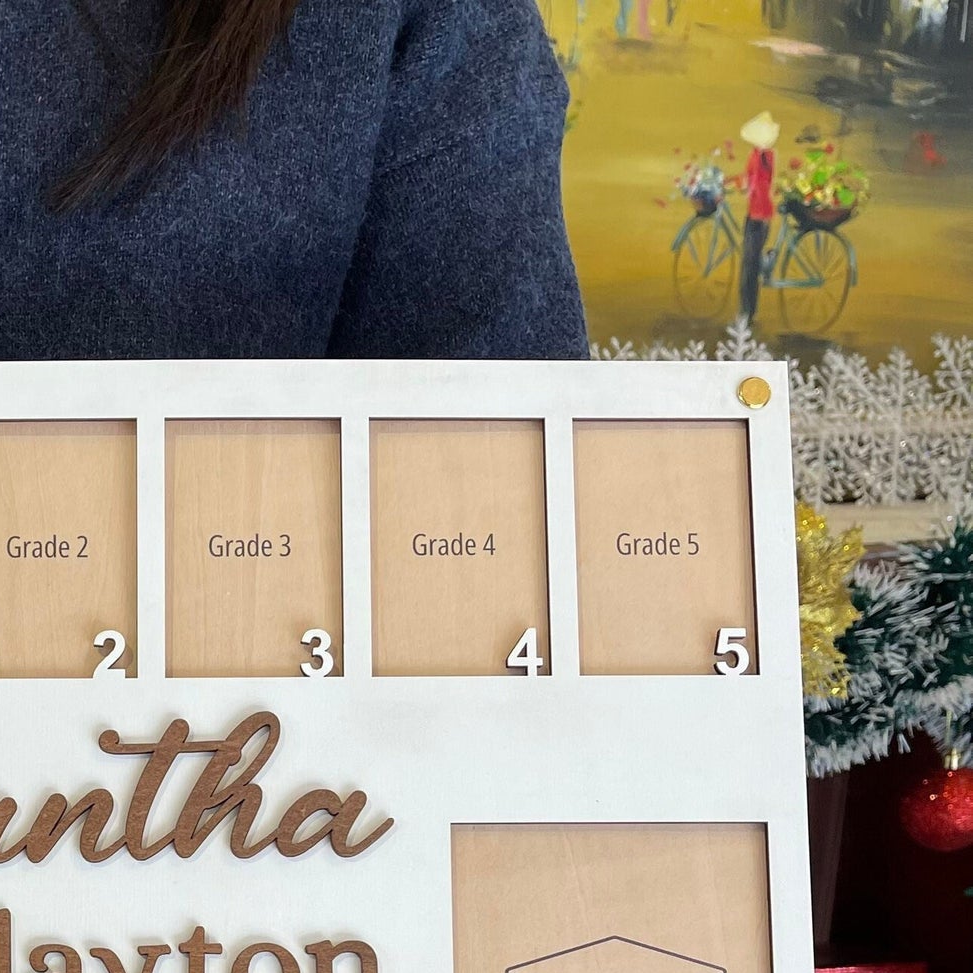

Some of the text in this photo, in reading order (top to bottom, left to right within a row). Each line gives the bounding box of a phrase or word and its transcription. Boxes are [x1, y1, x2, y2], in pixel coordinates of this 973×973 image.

[5, 534, 89, 558] Grade 2
[208, 533, 292, 558] Grade 3
[411, 532, 496, 557] Grade 4
[615, 532, 700, 556] Grade 5
[92, 630, 127, 679] 2
[299, 628, 334, 677] 3
[506, 627, 544, 677] 4
[713, 627, 750, 676] 5
